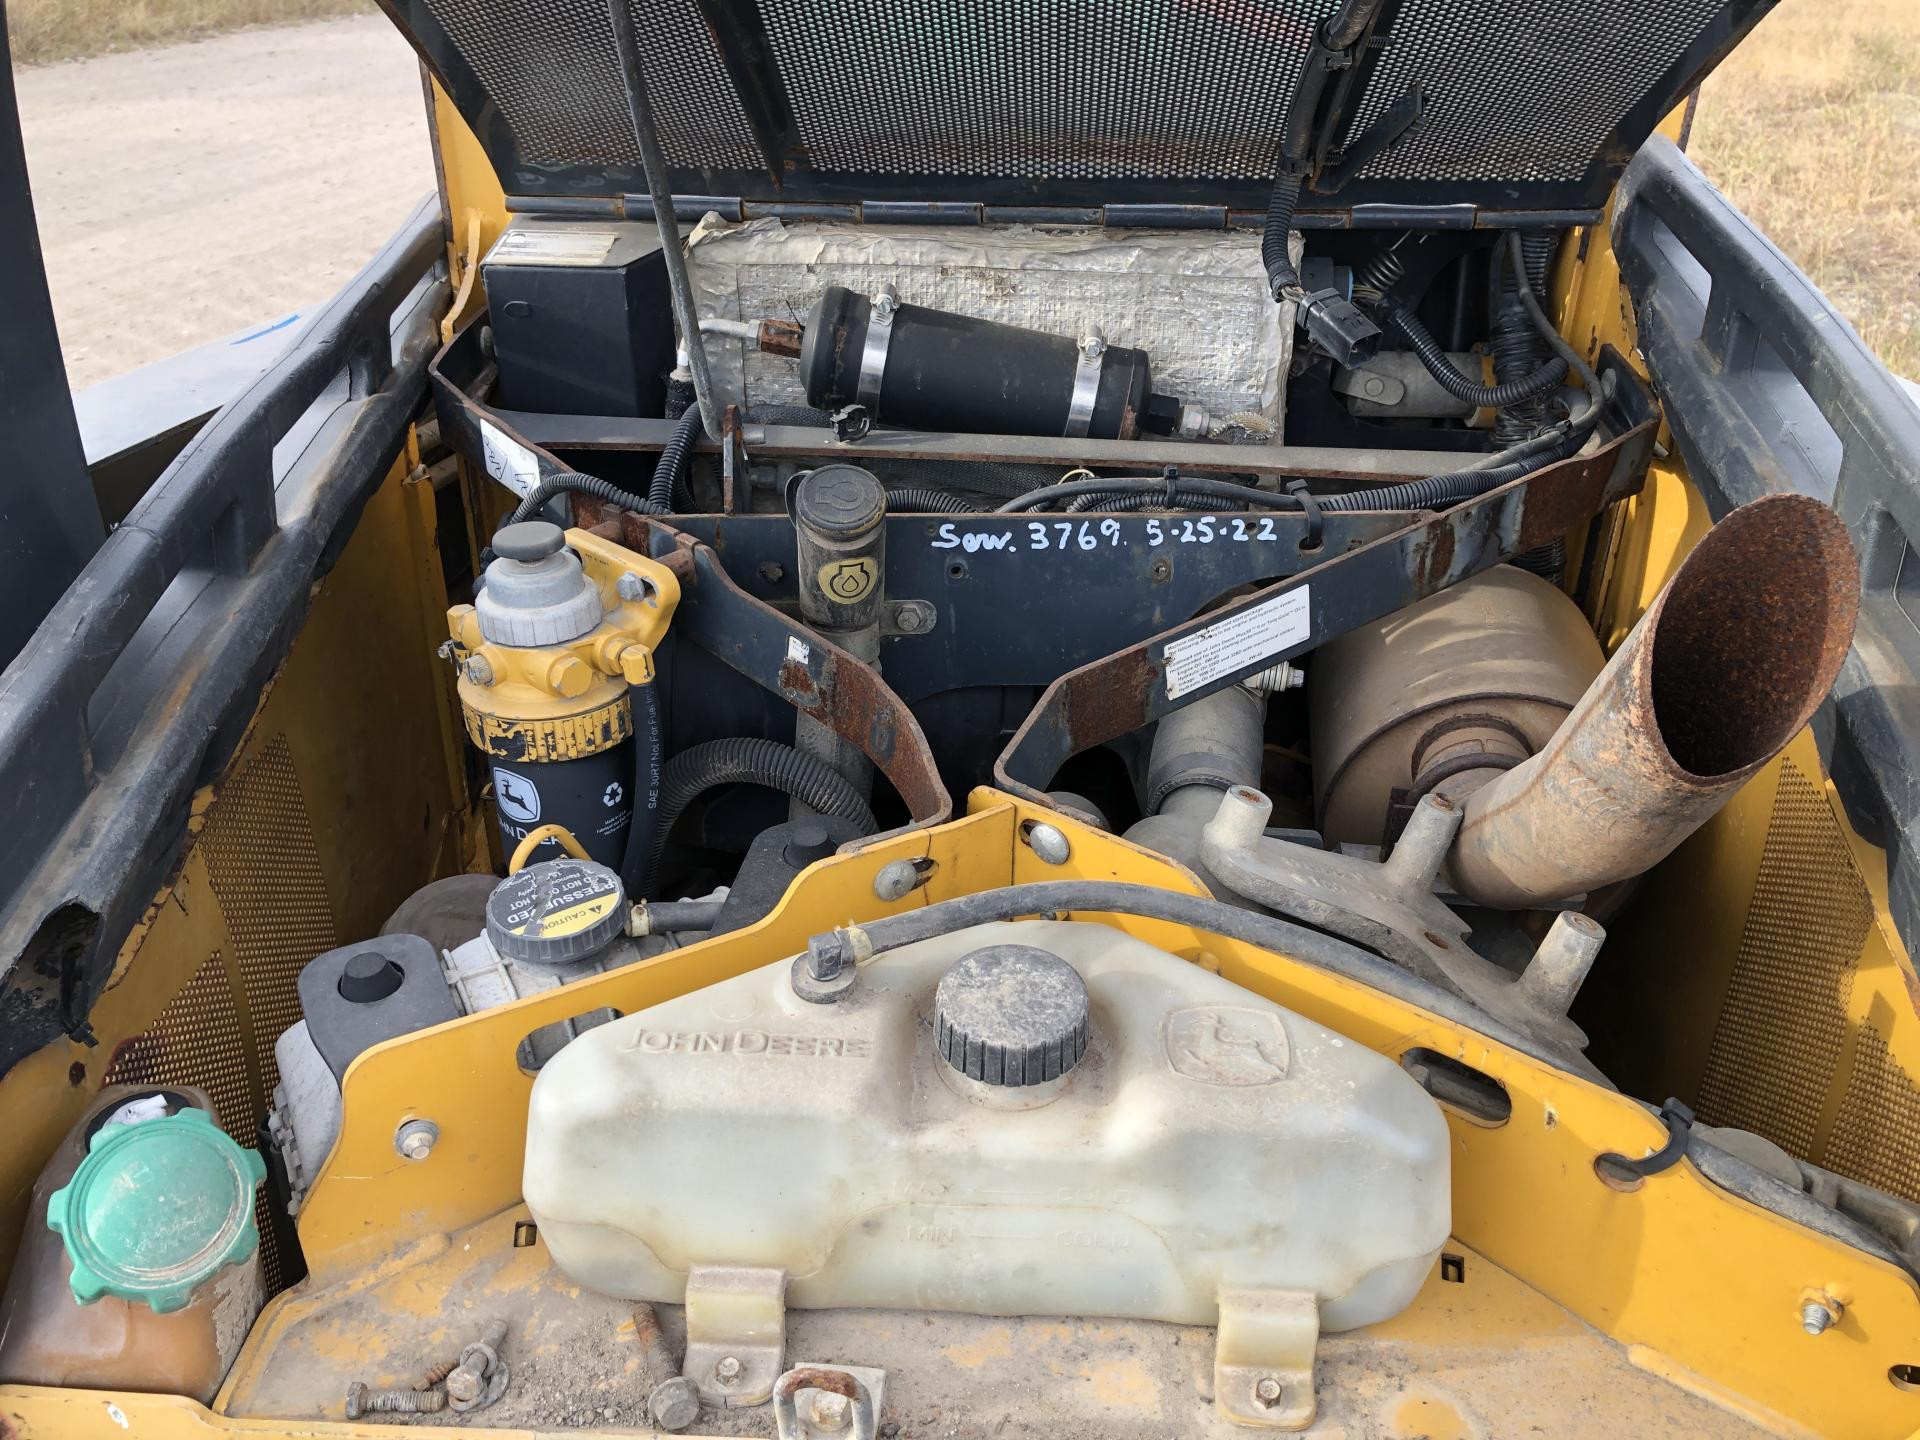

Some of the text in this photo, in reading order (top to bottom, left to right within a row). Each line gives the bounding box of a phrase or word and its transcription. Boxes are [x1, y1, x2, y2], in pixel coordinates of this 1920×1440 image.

[648, 788, 660, 810] SAE
[510, 898, 531, 912] HOT
[543, 910, 587, 931] CAUTION
[617, 1027, 873, 1059] JOHN DEERE
